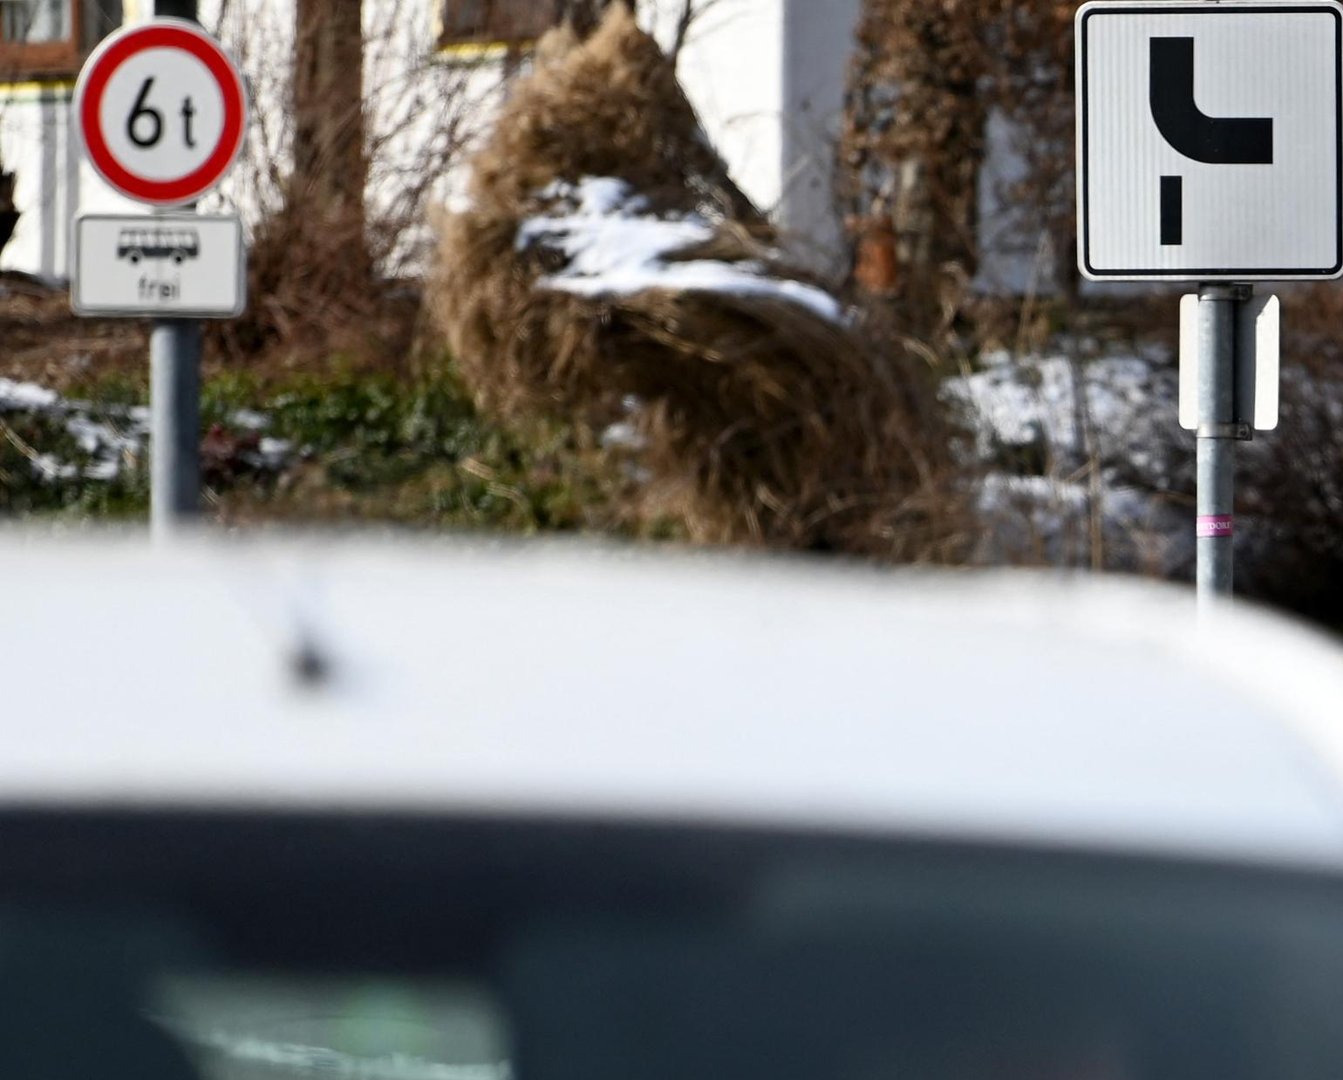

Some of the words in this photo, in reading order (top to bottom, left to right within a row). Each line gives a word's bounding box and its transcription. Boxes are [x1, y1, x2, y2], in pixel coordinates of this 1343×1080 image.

[127, 77, 163, 148] 6
[182, 97, 196, 147] t
[137, 277, 181, 300] frei
